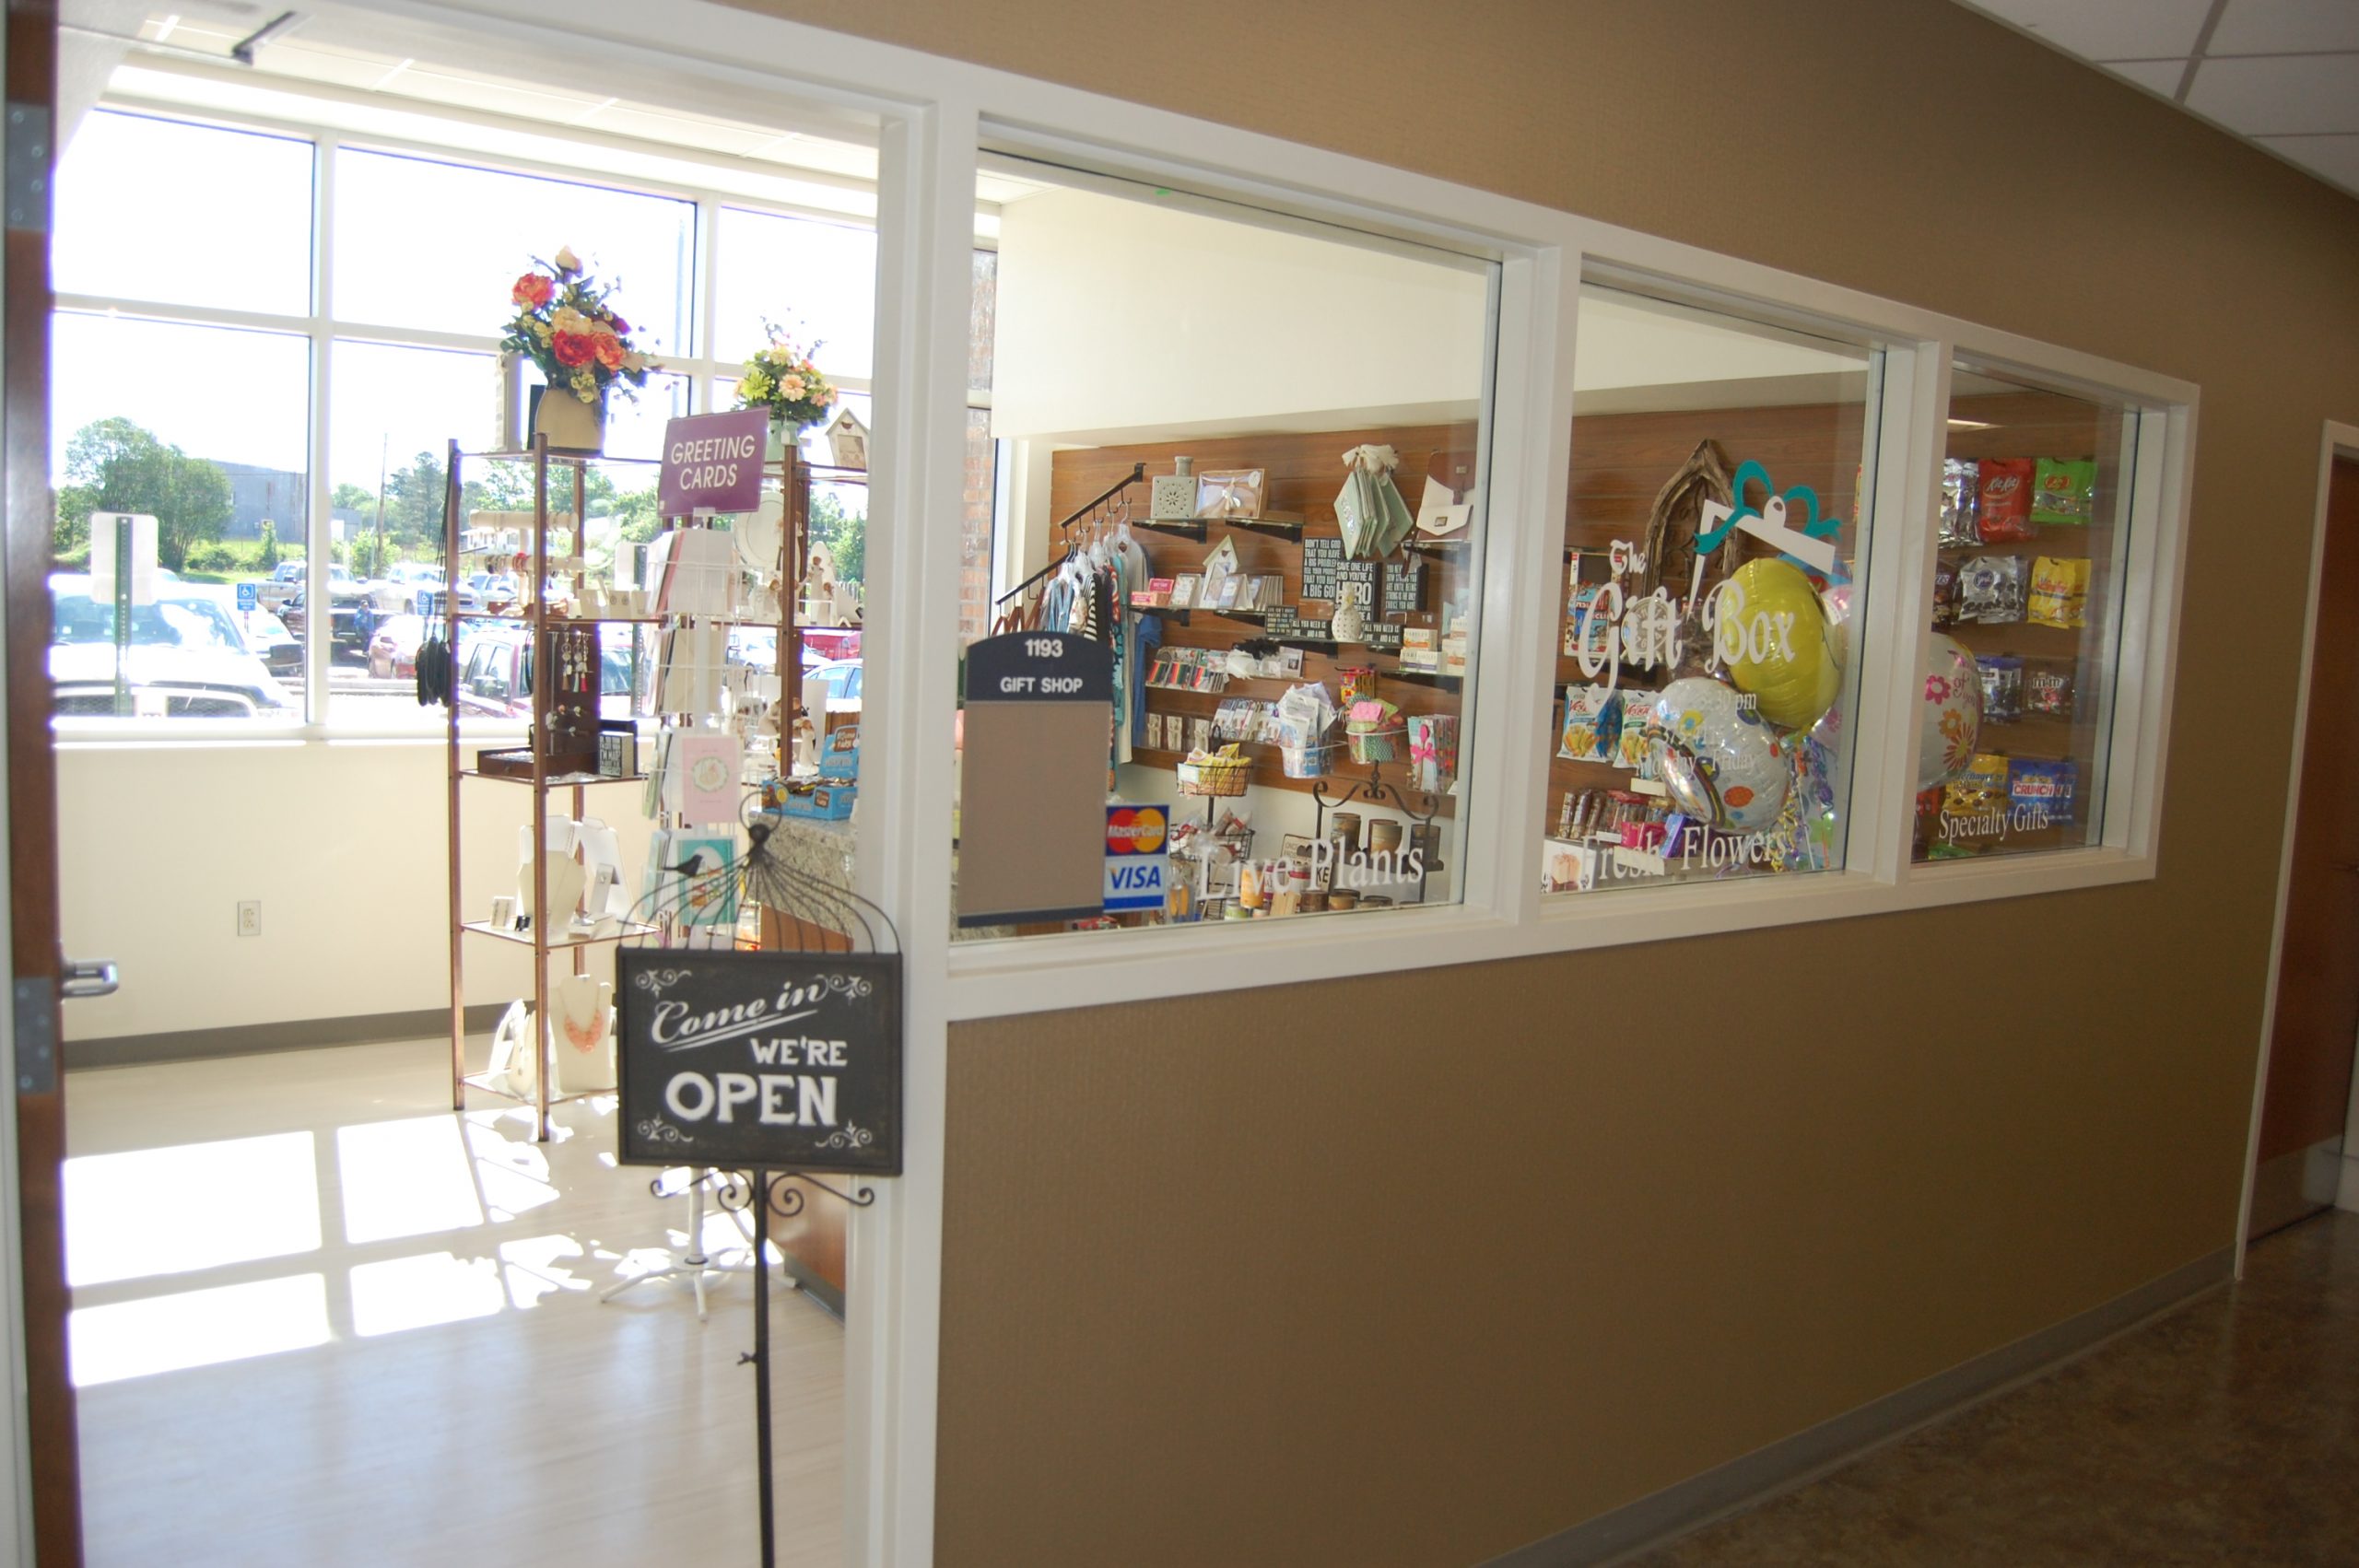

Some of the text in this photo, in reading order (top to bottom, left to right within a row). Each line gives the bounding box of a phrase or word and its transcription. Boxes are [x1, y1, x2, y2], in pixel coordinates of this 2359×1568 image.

[671, 435, 756, 465] GREETING
[680, 463, 738, 491] CARDS
[1336, 562, 1373, 572] SAVE ONE LIFE
[1609, 539, 1647, 575] The
[1336, 571, 1373, 581] AND YOU'RE A
[1302, 584, 1308, 597] A
[1309, 584, 1322, 598] BIG
[1336, 581, 1373, 605] HRO
[1025, 638, 1063, 658] 1193
[1578, 579, 1796, 715] Gift Box
[1000, 676, 1084, 694] GIFT SHOP
[1735, 693, 1757, 715] pm
[1636, 749, 1756, 778] Moday Friday
[2013, 784, 2054, 797] CRUNCH
[1107, 825, 1165, 838] MasterCard
[1938, 803, 2048, 847] Specialty Gifts
[1582, 825, 1786, 881] Fresh Flowers
[1109, 865, 1161, 891] VISA
[1195, 836, 1425, 901] Live Plants
[651, 974, 829, 1045] Come in
[749, 1036, 848, 1067] WE'RE
[664, 1071, 839, 1127] OPEN
